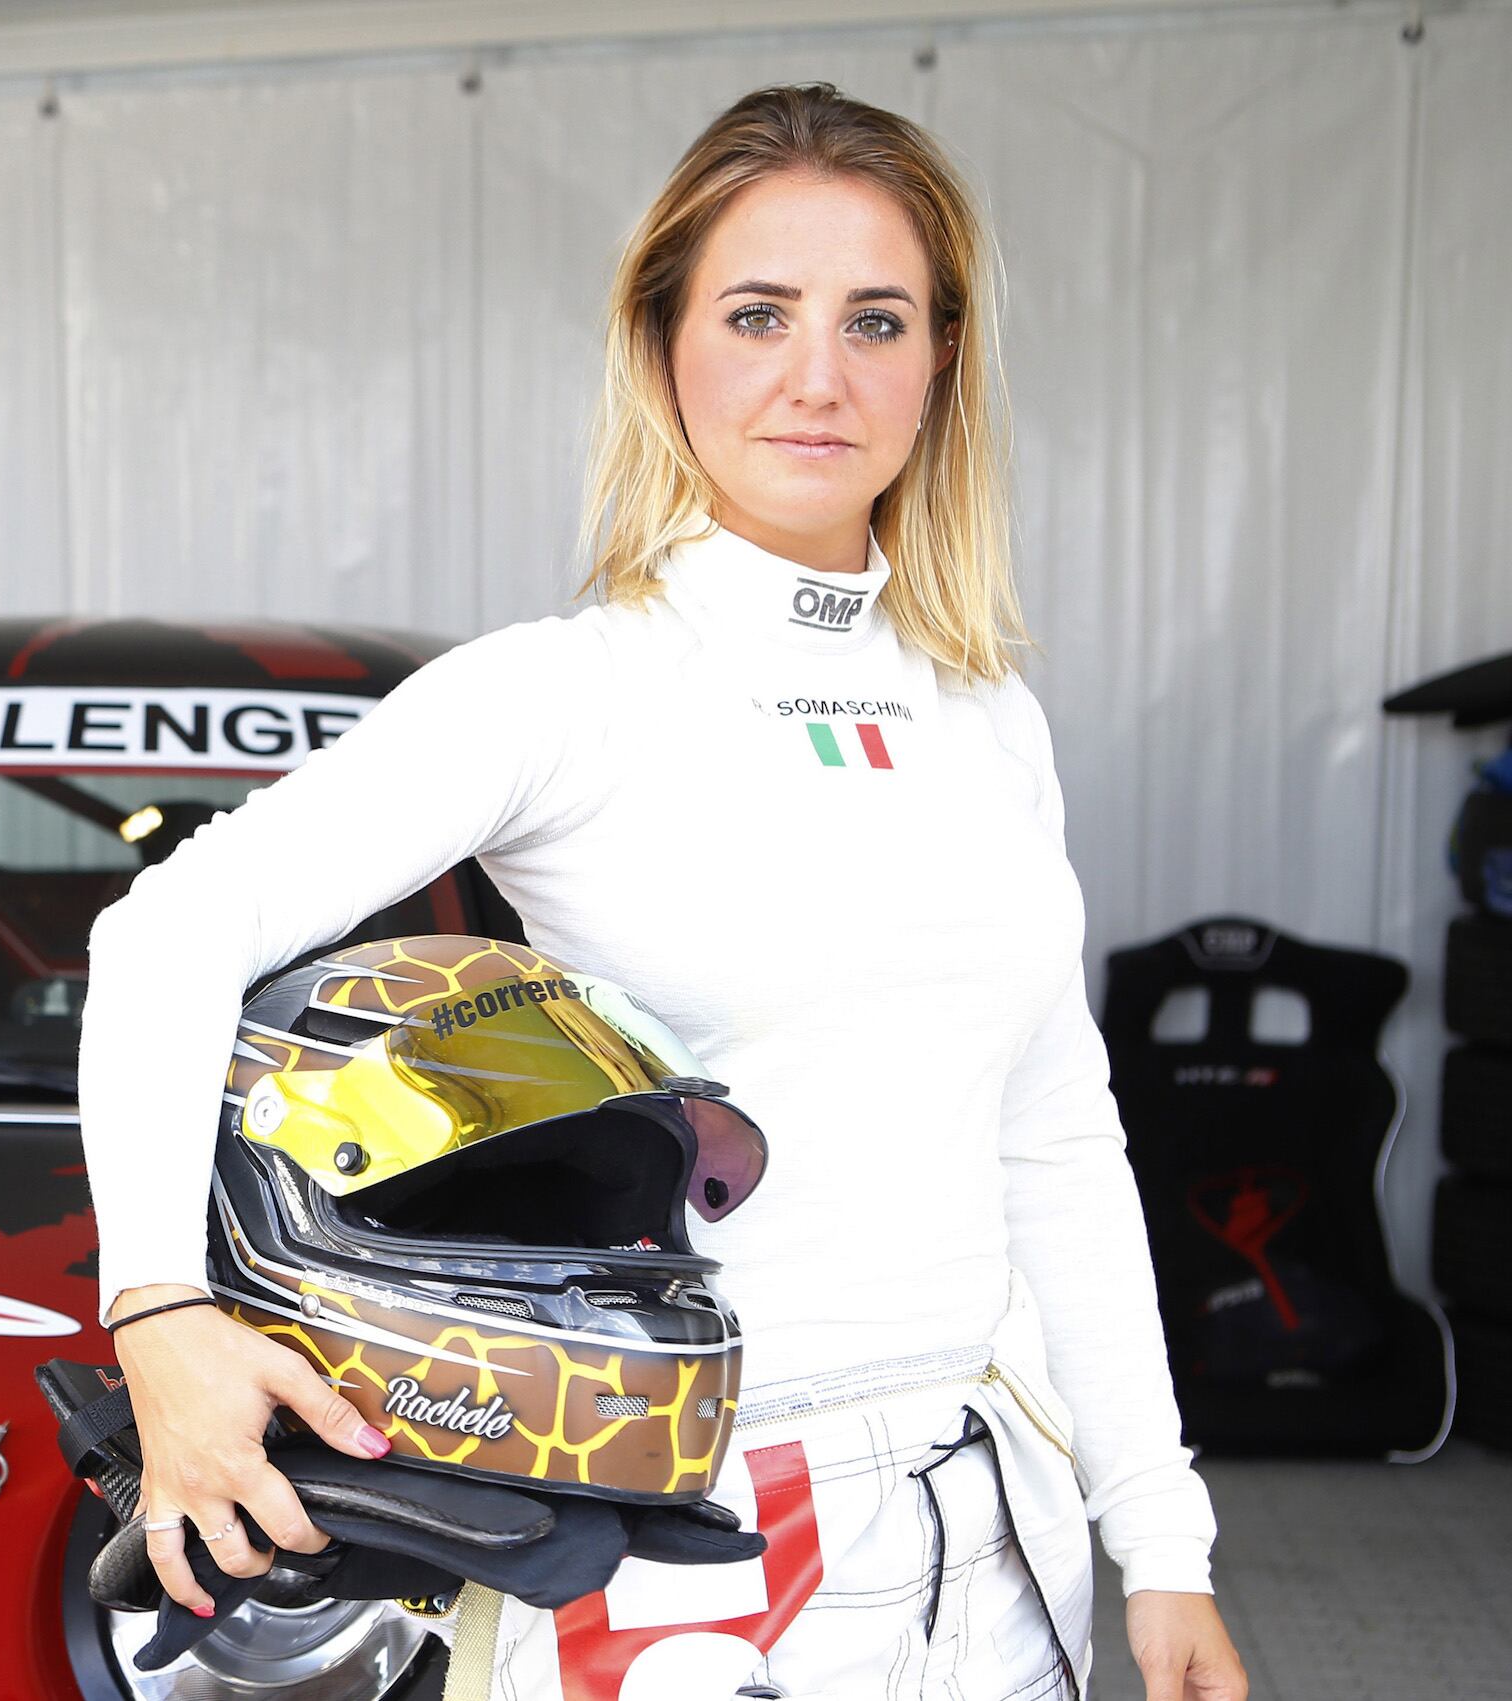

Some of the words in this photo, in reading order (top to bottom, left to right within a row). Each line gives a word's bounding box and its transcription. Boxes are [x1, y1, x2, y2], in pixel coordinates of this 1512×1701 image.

[792, 587, 864, 625] OMP
[776, 697, 914, 723] SOMASCHINI
[384, 1376, 514, 1440] Rachele
